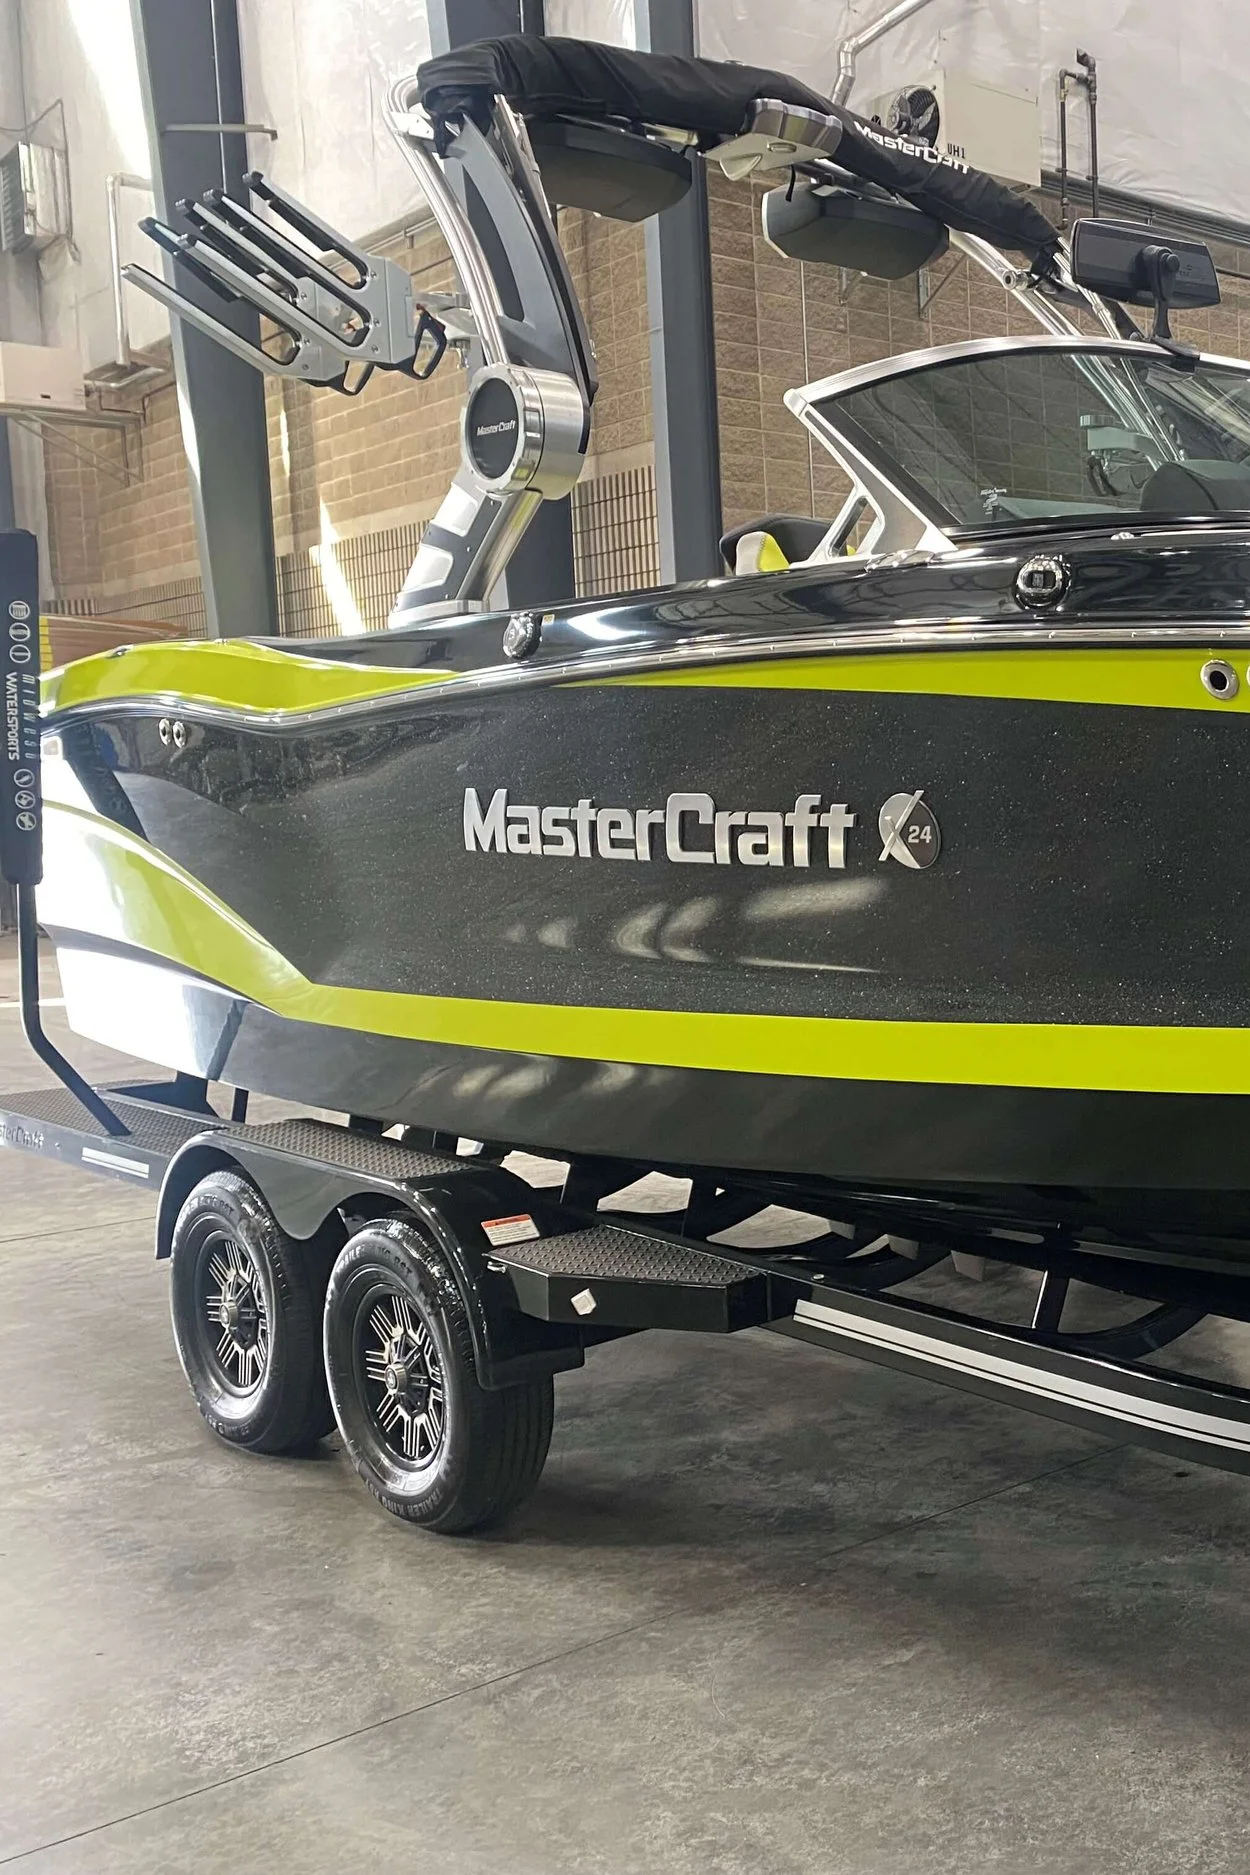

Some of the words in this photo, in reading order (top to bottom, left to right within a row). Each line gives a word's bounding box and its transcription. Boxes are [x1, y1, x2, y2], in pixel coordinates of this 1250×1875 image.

[853, 120, 970, 175] MasterCraft
[476, 419, 516, 437] MasterCraft
[5, 672, 20, 761] WATERSPORTS
[462, 787, 857, 869] MasterCraft
